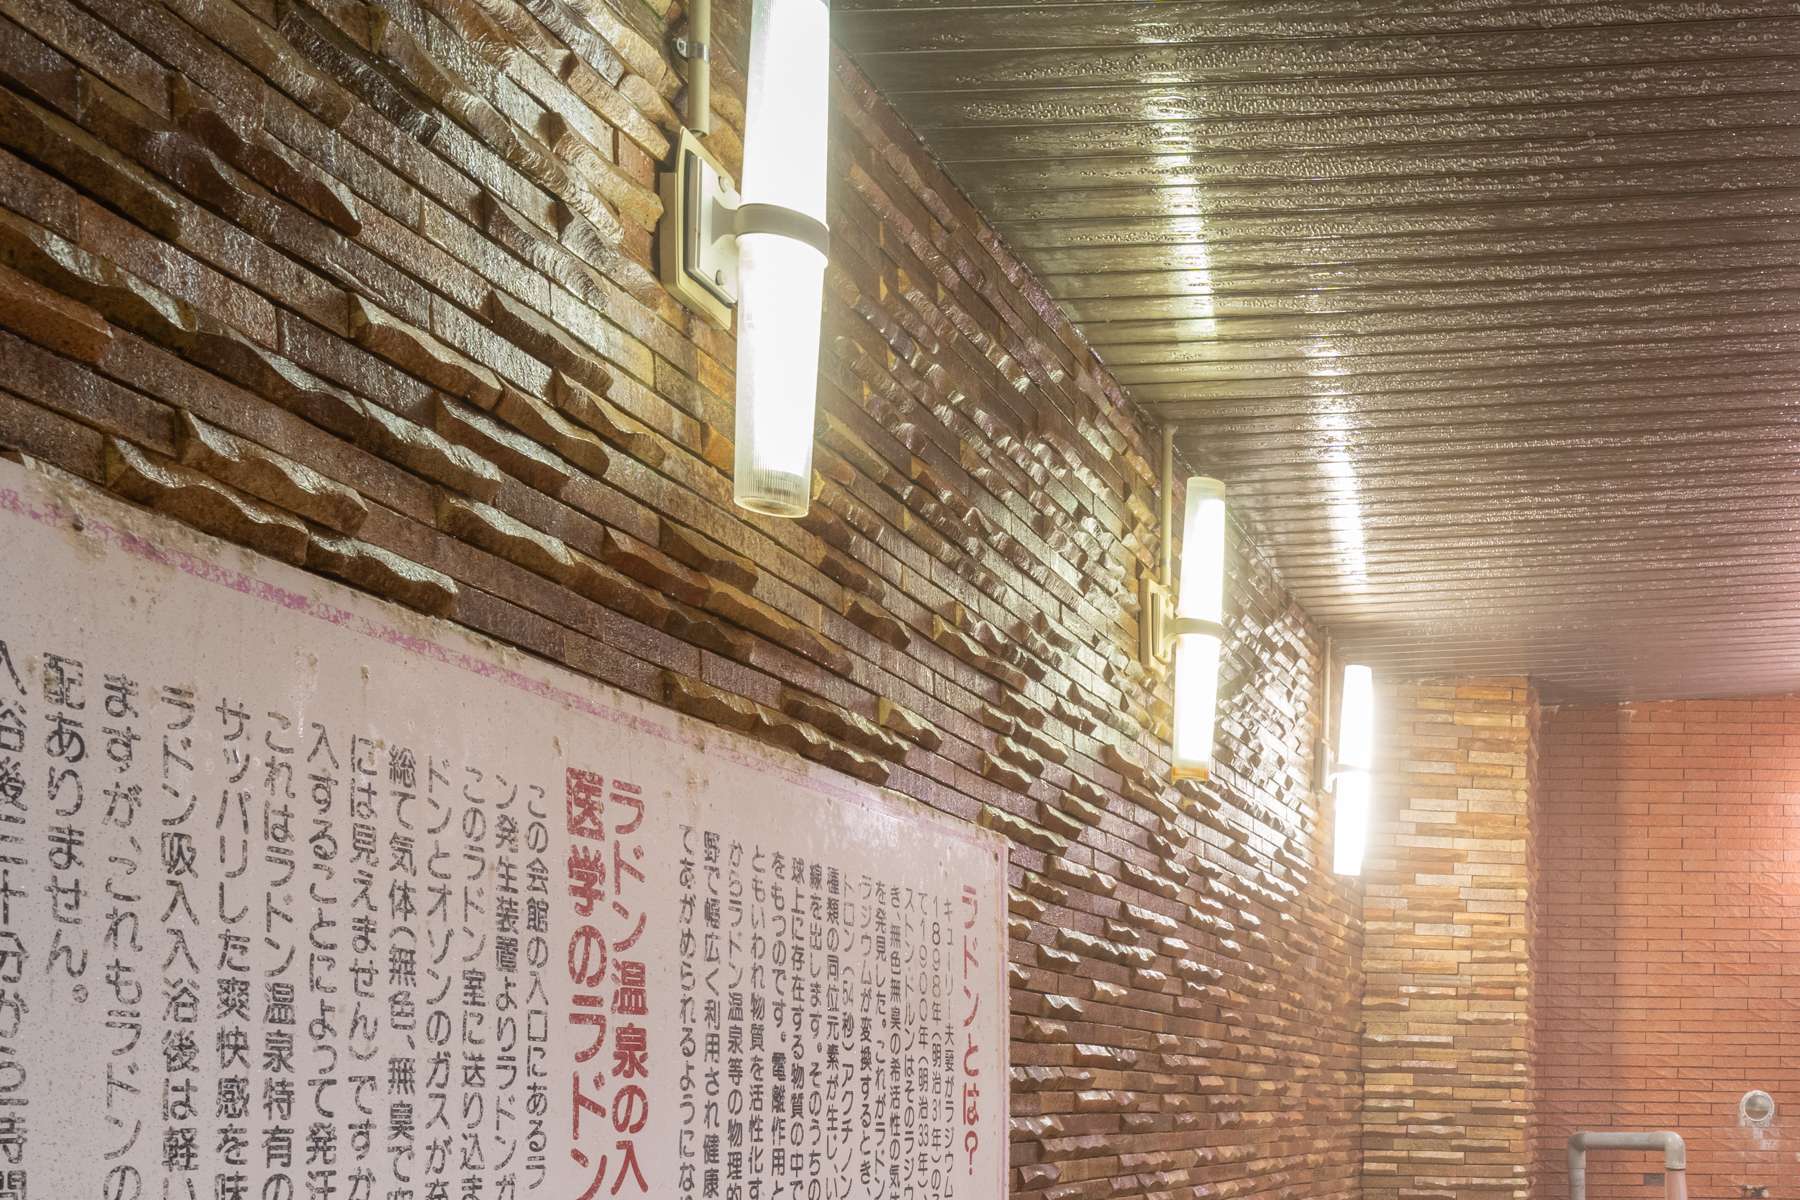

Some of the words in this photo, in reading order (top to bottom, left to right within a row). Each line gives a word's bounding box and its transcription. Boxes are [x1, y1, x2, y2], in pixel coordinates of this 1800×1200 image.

[43, 651, 89, 1004] 配ありません。
[962, 885, 981, 1176] ラドンとは？
